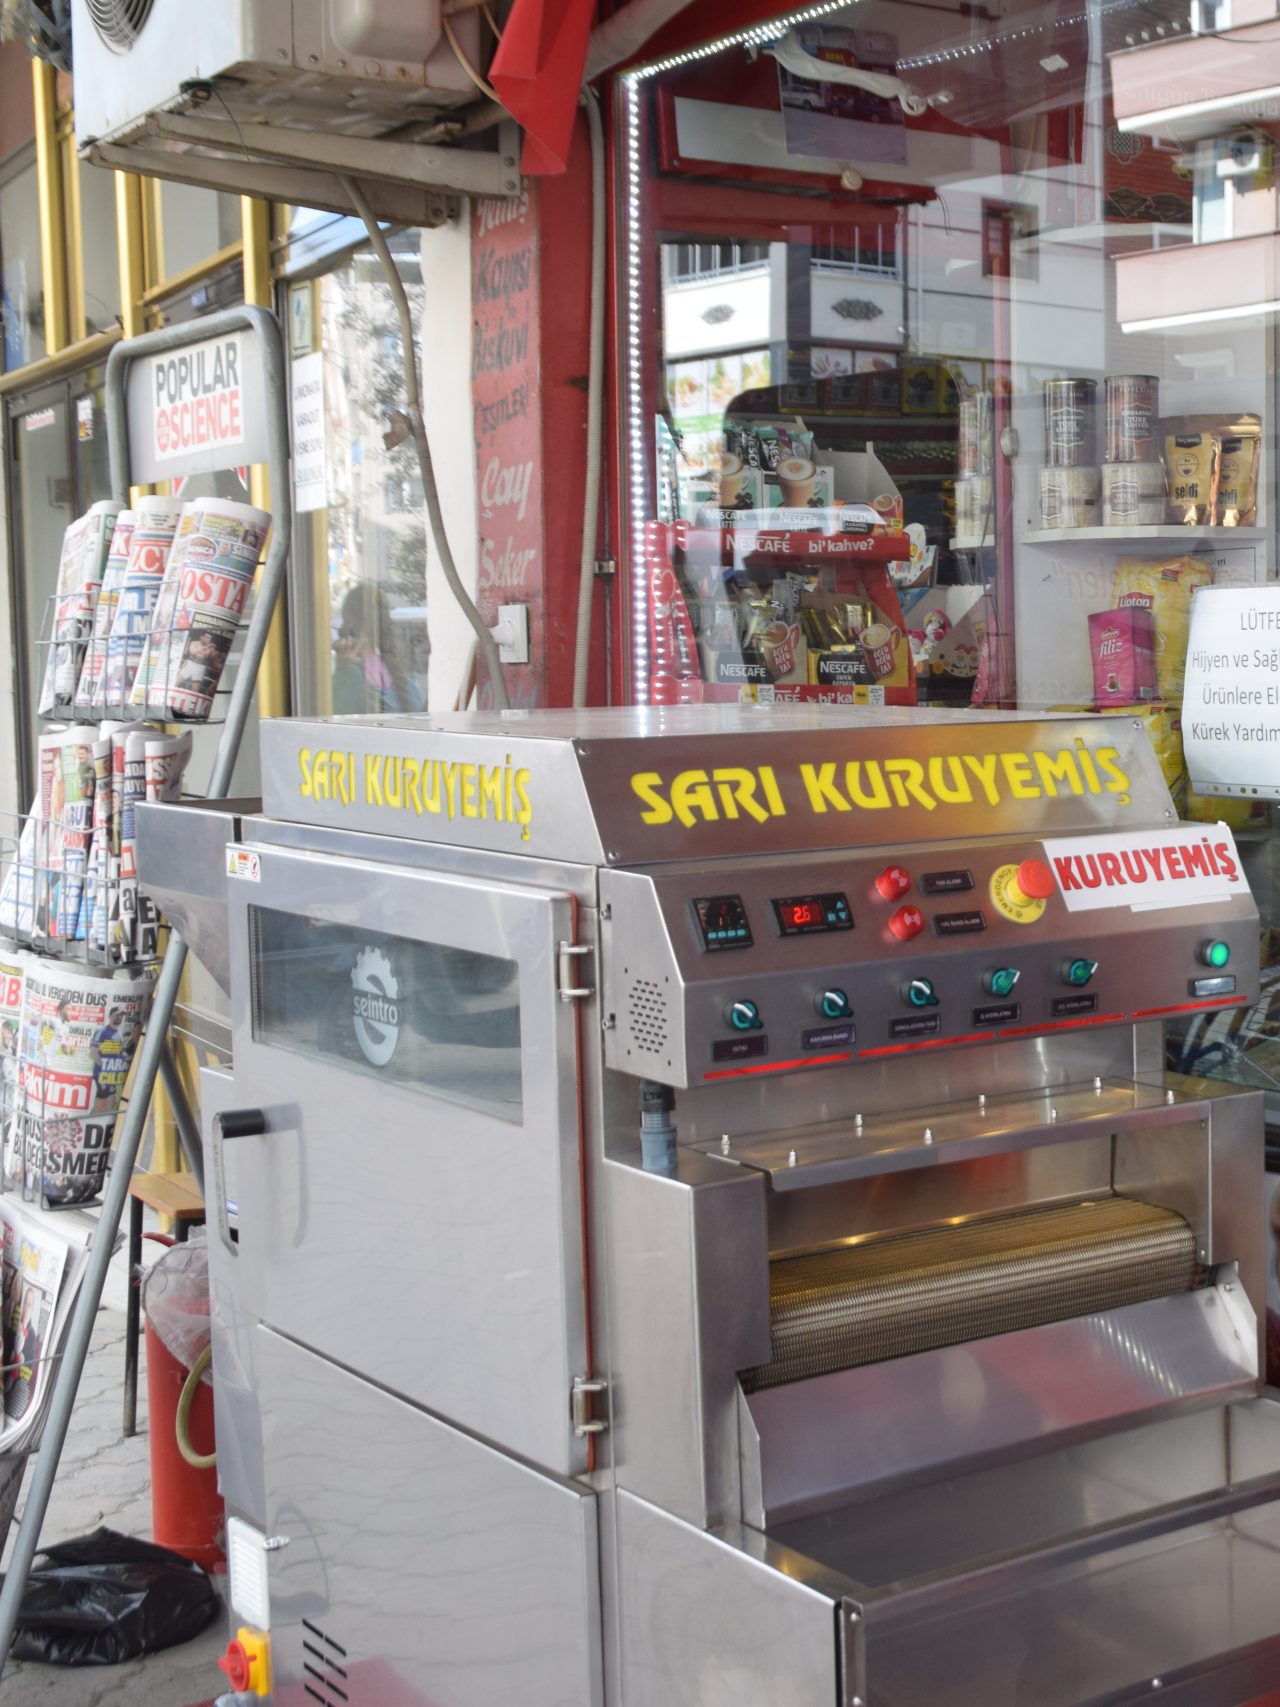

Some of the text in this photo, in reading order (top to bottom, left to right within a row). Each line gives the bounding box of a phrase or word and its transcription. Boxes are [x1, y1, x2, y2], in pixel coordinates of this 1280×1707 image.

[156, 341, 239, 407] POPULAR
[170, 389, 241, 450] SCIENCE
[178, 570, 250, 614] OSTA
[1192, 650, 1229, 673] Hijyen
[1233, 655, 1249, 667] ve
[1202, 683, 1262, 705] Ürünlere
[1267, 685, 1279, 704] El
[1192, 722, 1230, 742] Kürek
[299, 747, 532, 841] SARI KURUYEMİŞ
[630, 737, 1132, 829] SARI KURUYEMİŞ
[1053, 837, 1240, 892] KURUYEMİŞ
[353, 992, 398, 1025] seintro
